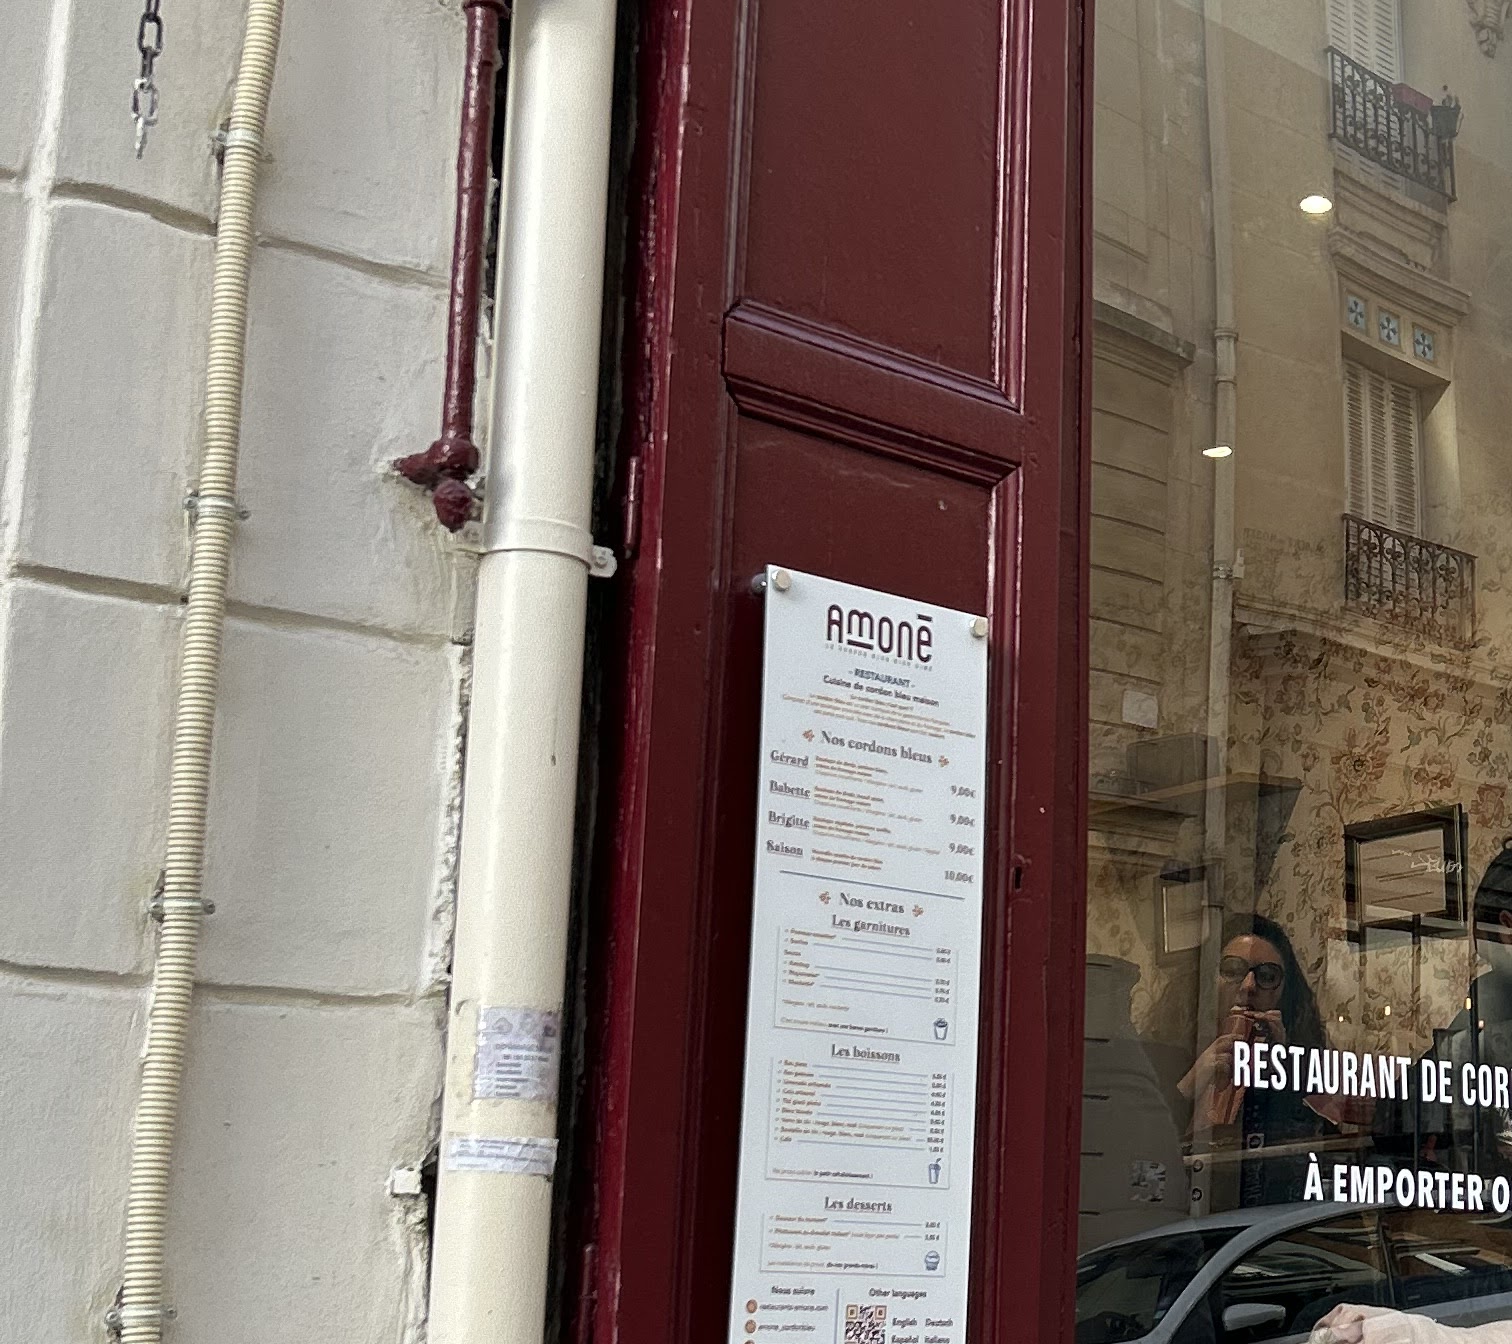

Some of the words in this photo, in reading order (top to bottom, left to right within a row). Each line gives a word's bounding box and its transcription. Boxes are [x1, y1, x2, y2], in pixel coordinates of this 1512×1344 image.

[854, 668, 911, 688] RESTAURANT
[821, 730, 845, 747] Nos
[848, 736, 898, 758] cordons
[900, 745, 933, 765] bleus
[770, 749, 809, 768] Gérard
[770, 780, 811, 799] Babette
[768, 810, 810, 829] Brigitte
[766, 839, 804, 856] Saison
[839, 893, 864, 909] Nos
[866, 898, 905, 914] extras
[832, 914, 851, 928] Les
[854, 920, 911, 937] garnitures
[832, 1044, 850, 1058] Les
[853, 1046, 901, 1062] boissons
[1234, 1040, 1412, 1100] RESTAURANT
[1421, 1058, 1453, 1104] DE
[1303, 1152, 1324, 1201] À
[1333, 1164, 1484, 1211] EMPORTER
[824, 1196, 844, 1210] Les
[846, 1198, 892, 1213] desserts
[869, 1288, 890, 1298] Other
[892, 1289, 927, 1300] languages
